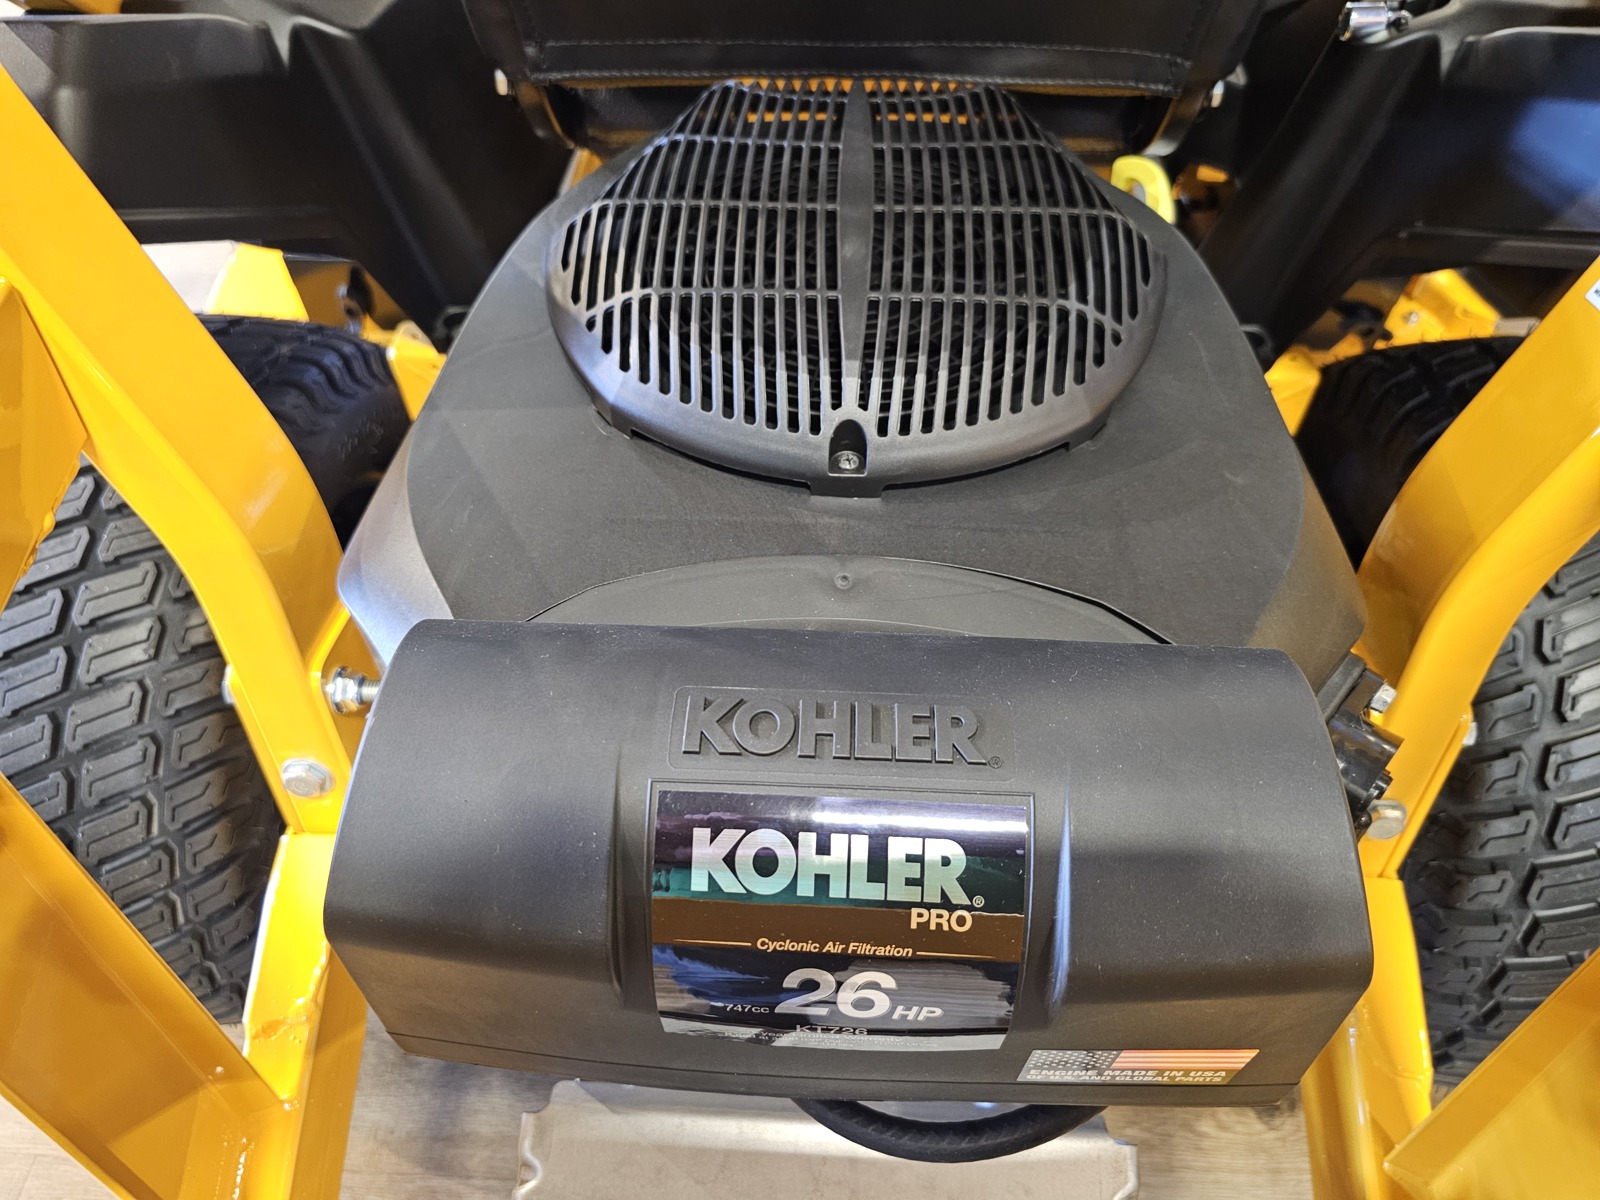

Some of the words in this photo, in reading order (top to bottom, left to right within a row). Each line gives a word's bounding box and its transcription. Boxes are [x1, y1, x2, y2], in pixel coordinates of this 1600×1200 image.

[910, 907, 973, 933] PRO
[756, 937, 820, 953] Cyclonic
[822, 941, 846, 954] Air
[848, 942, 913, 958] Filtration
[726, 1003, 770, 1014] 747cc
[774, 967, 899, 1019] 26
[891, 1004, 945, 1022] HP
[795, 1024, 868, 1035] KT726
[1102, 1069, 1159, 1077] MADE
